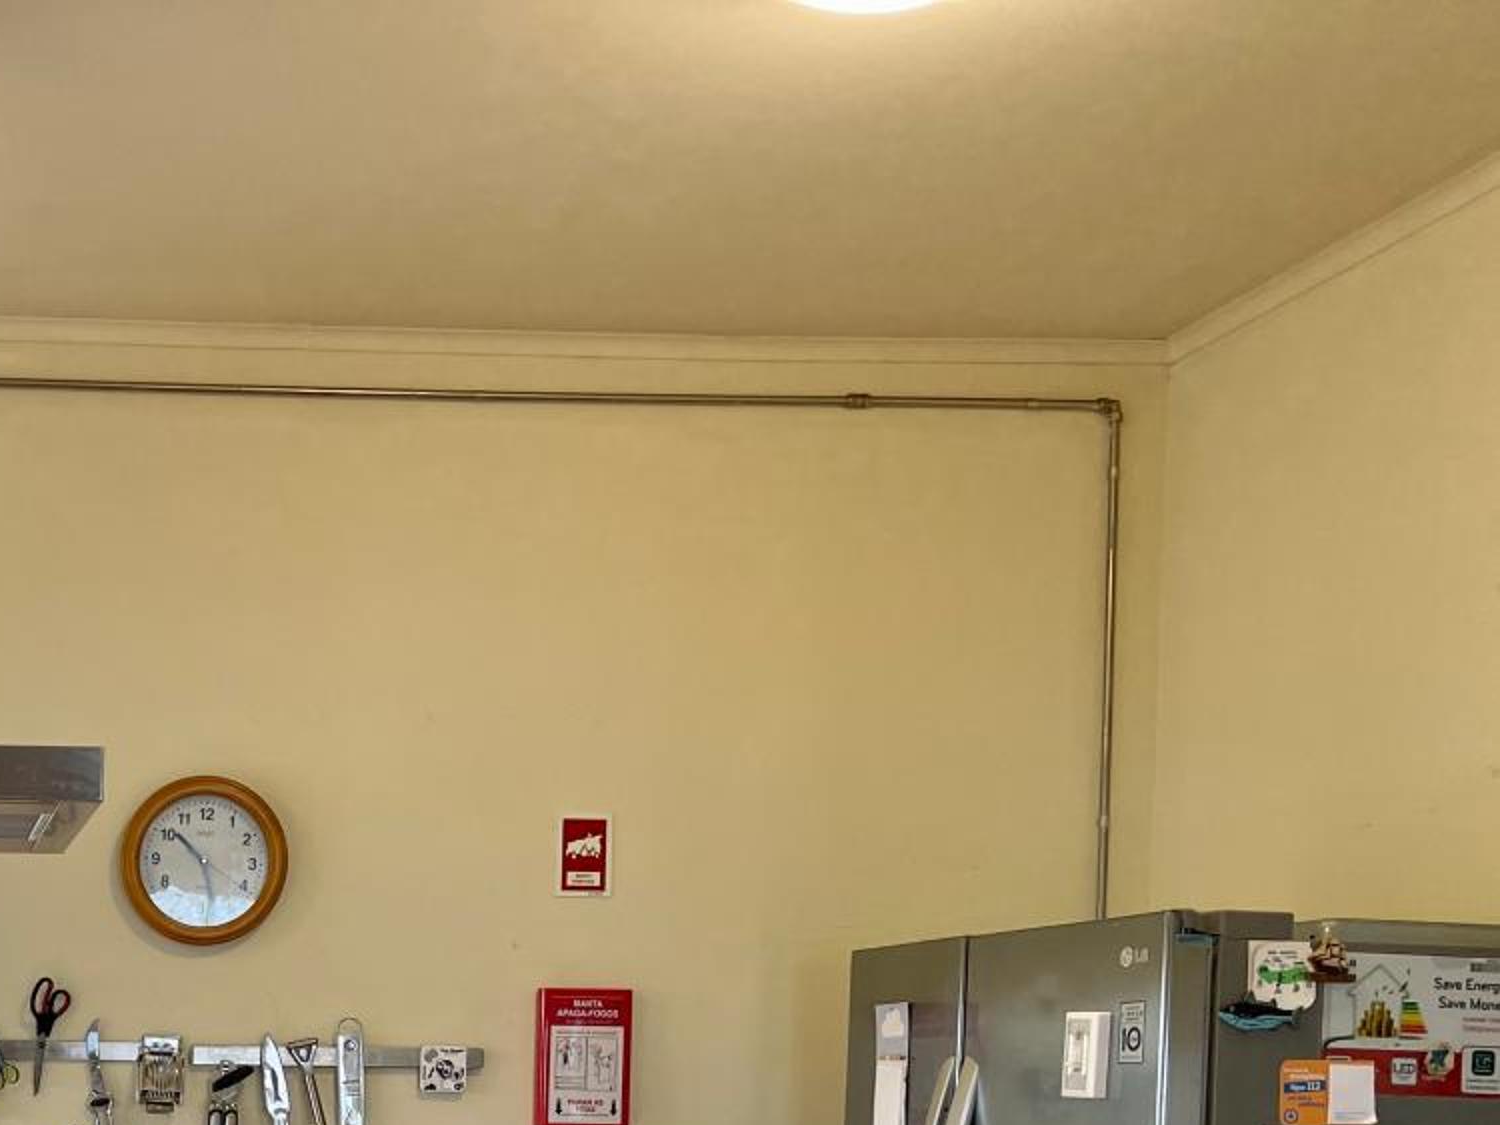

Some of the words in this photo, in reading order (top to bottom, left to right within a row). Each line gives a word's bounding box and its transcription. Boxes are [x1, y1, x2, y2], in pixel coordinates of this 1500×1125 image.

[178, 813, 191, 826] 11
[199, 807, 216, 821] 12
[160, 828, 176, 841] 10
[243, 832, 252, 846] 2
[151, 851, 161, 865] 9
[247, 857, 257, 871] 3
[161, 875, 169, 889] 8
[238, 879, 248, 891] 4
[1433, 977, 1463, 991] Save
[573, 999, 604, 1008] MANTA
[1438, 995, 1466, 1009] Save
[1121, 1026, 1141, 1052] 10
[1394, 1063, 1415, 1073] LED
